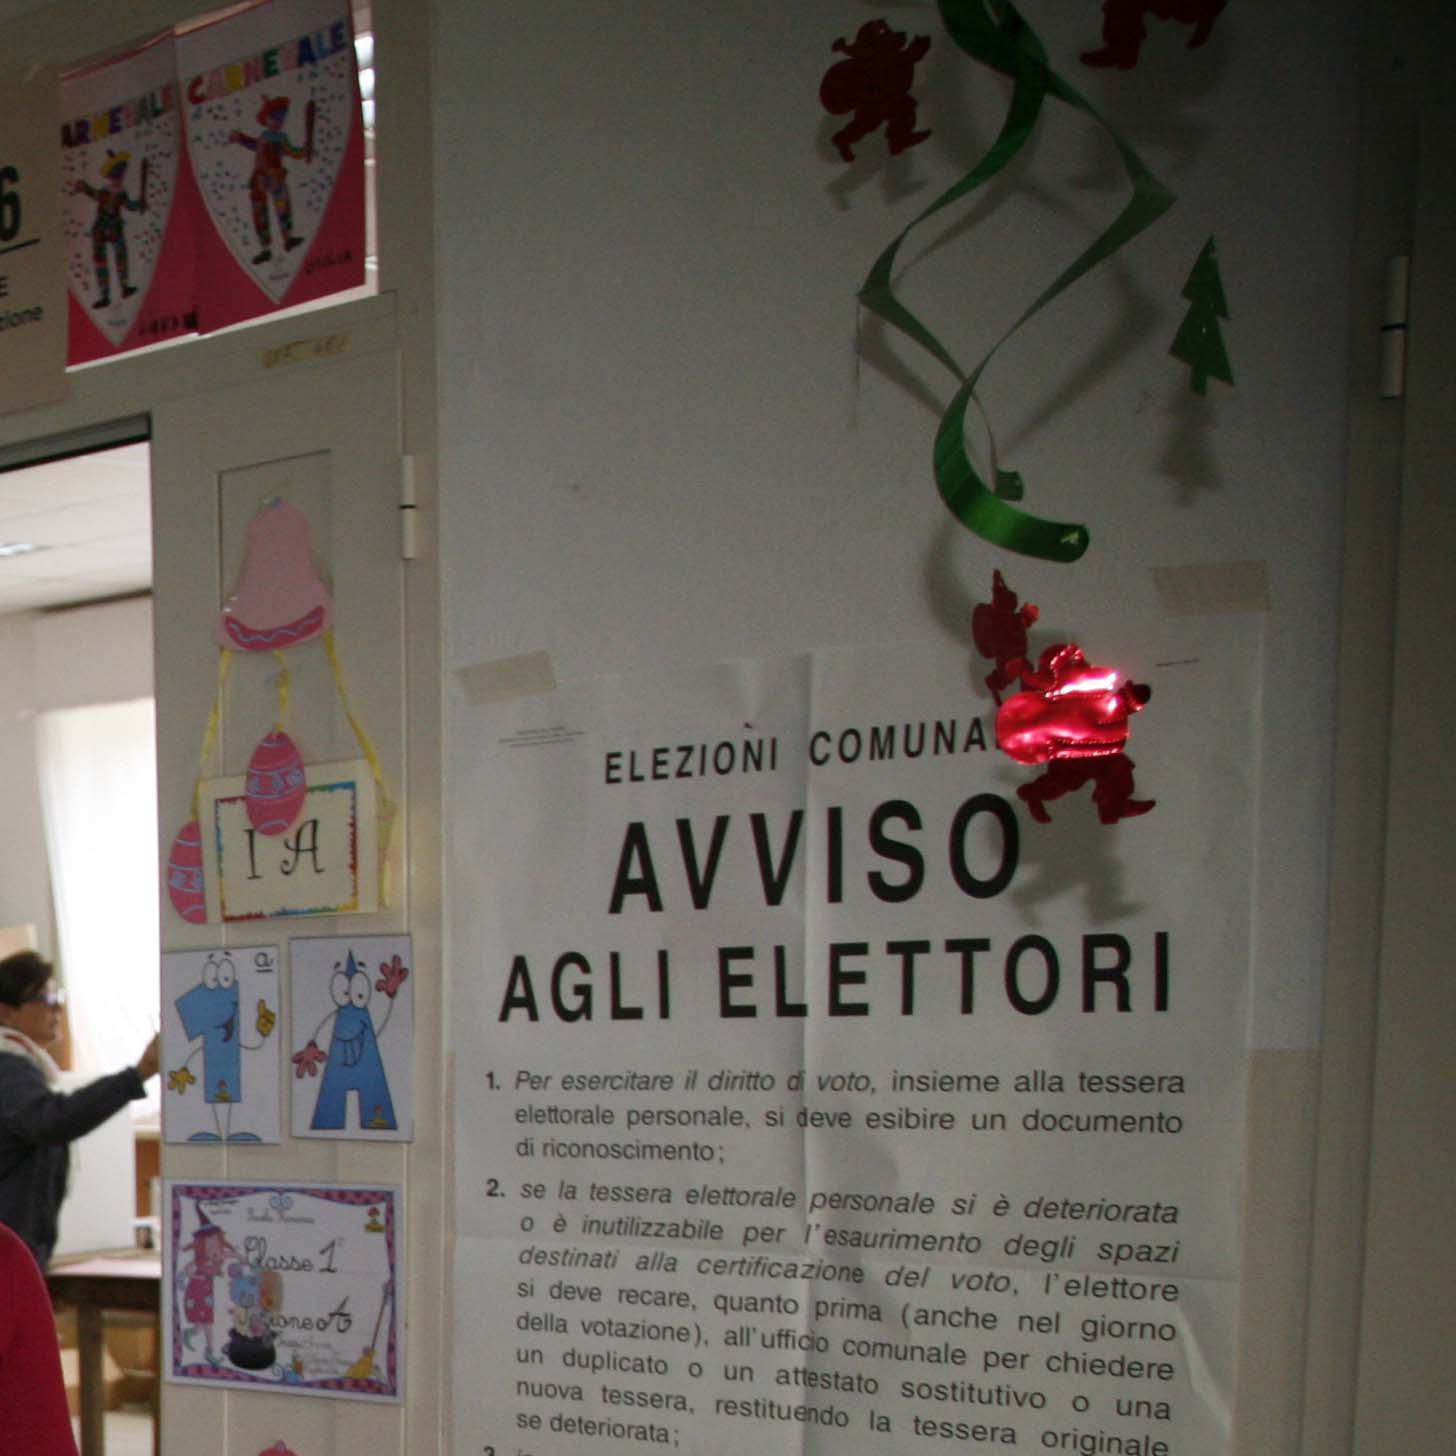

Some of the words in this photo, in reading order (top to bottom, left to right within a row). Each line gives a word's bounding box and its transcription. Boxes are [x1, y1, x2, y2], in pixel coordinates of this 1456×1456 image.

[61, 82, 176, 149] ARNEVALE
[604, 735, 779, 785] ELEZIONI
[808, 719, 996, 768] COMUNA
[245, 828, 262, 880] I
[280, 818, 324, 876] A
[608, 793, 1020, 914] AVVISO
[498, 949, 672, 1024] AGLI
[718, 930, 1171, 1019] ELETTORI
[485, 1070, 501, 1091] 1.
[514, 1069, 553, 1091] Per
[560, 1071, 675, 1092] esercitare
[684, 1069, 699, 1091] il
[707, 1069, 776, 1092] diritto
[786, 1068, 806, 1093] di
[817, 1071, 876, 1095] voto,
[891, 1069, 1001, 1093] insieme
[1013, 1069, 1065, 1094] alla
[1077, 1071, 1186, 1095] tessera
[514, 1104, 615, 1126] elettorale
[626, 1105, 751, 1131] personale,
[764, 1109, 785, 1128] si
[795, 1104, 853, 1134] deve
[865, 1107, 956, 1131] esibire
[971, 1112, 1007, 1131] un
[1021, 1108, 1184, 1135] documento
[515, 1137, 535, 1158] di
[485, 1177, 506, 1198] 2.
[520, 1182, 547, 1200] se
[557, 1180, 578, 1201] la
[589, 1182, 673, 1204] tessera
[685, 1184, 798, 1209] elettorale
[808, 1191, 936, 1215] personale
[951, 1193, 977, 1216] si
[992, 1193, 1011, 1218] è
[1023, 1195, 1180, 1225] deteriorata
[518, 1245, 618, 1269] destinati
[634, 1251, 679, 1273] alla
[696, 1255, 865, 1285] certificazione
[884, 1264, 931, 1288] del
[951, 1271, 1019, 1296] voto,
[520, 1216, 535, 1232] o
[552, 1213, 568, 1234] è
[581, 1216, 724, 1241] inutilizzabile
[741, 1225, 786, 1247] per
[1003, 1233, 1077, 1264] degli
[1096, 1240, 1181, 1267] spazi
[517, 1281, 535, 1298] si
[548, 1280, 603, 1303] deve
[617, 1288, 697, 1311] recare,
[713, 1293, 800, 1316] quanto
[813, 1299, 883, 1323] prima
[1017, 1311, 1061, 1335] nel
[1080, 1314, 1178, 1343] giorno
[516, 1311, 569, 1334] della
[841, 1338, 968, 1366] comunale
[983, 1350, 1031, 1373] per
[1045, 1350, 1175, 1382] chiedere
[516, 1348, 544, 1365] un
[562, 1347, 669, 1376] duplicato
[687, 1361, 704, 1379] o
[723, 1365, 755, 1383] un
[774, 1366, 880, 1395] attestato
[900, 1380, 1047, 1410] sostitutivo
[1071, 1394, 1091, 1414] o
[1115, 1398, 1172, 1421] una
[516, 1380, 584, 1402] nuova
[601, 1385, 695, 1414] tessera,
[715, 1398, 850, 1428] restituendo
[869, 1409, 892, 1433] la
[912, 1415, 1017, 1445] tessera
[516, 1412, 543, 1431] se
